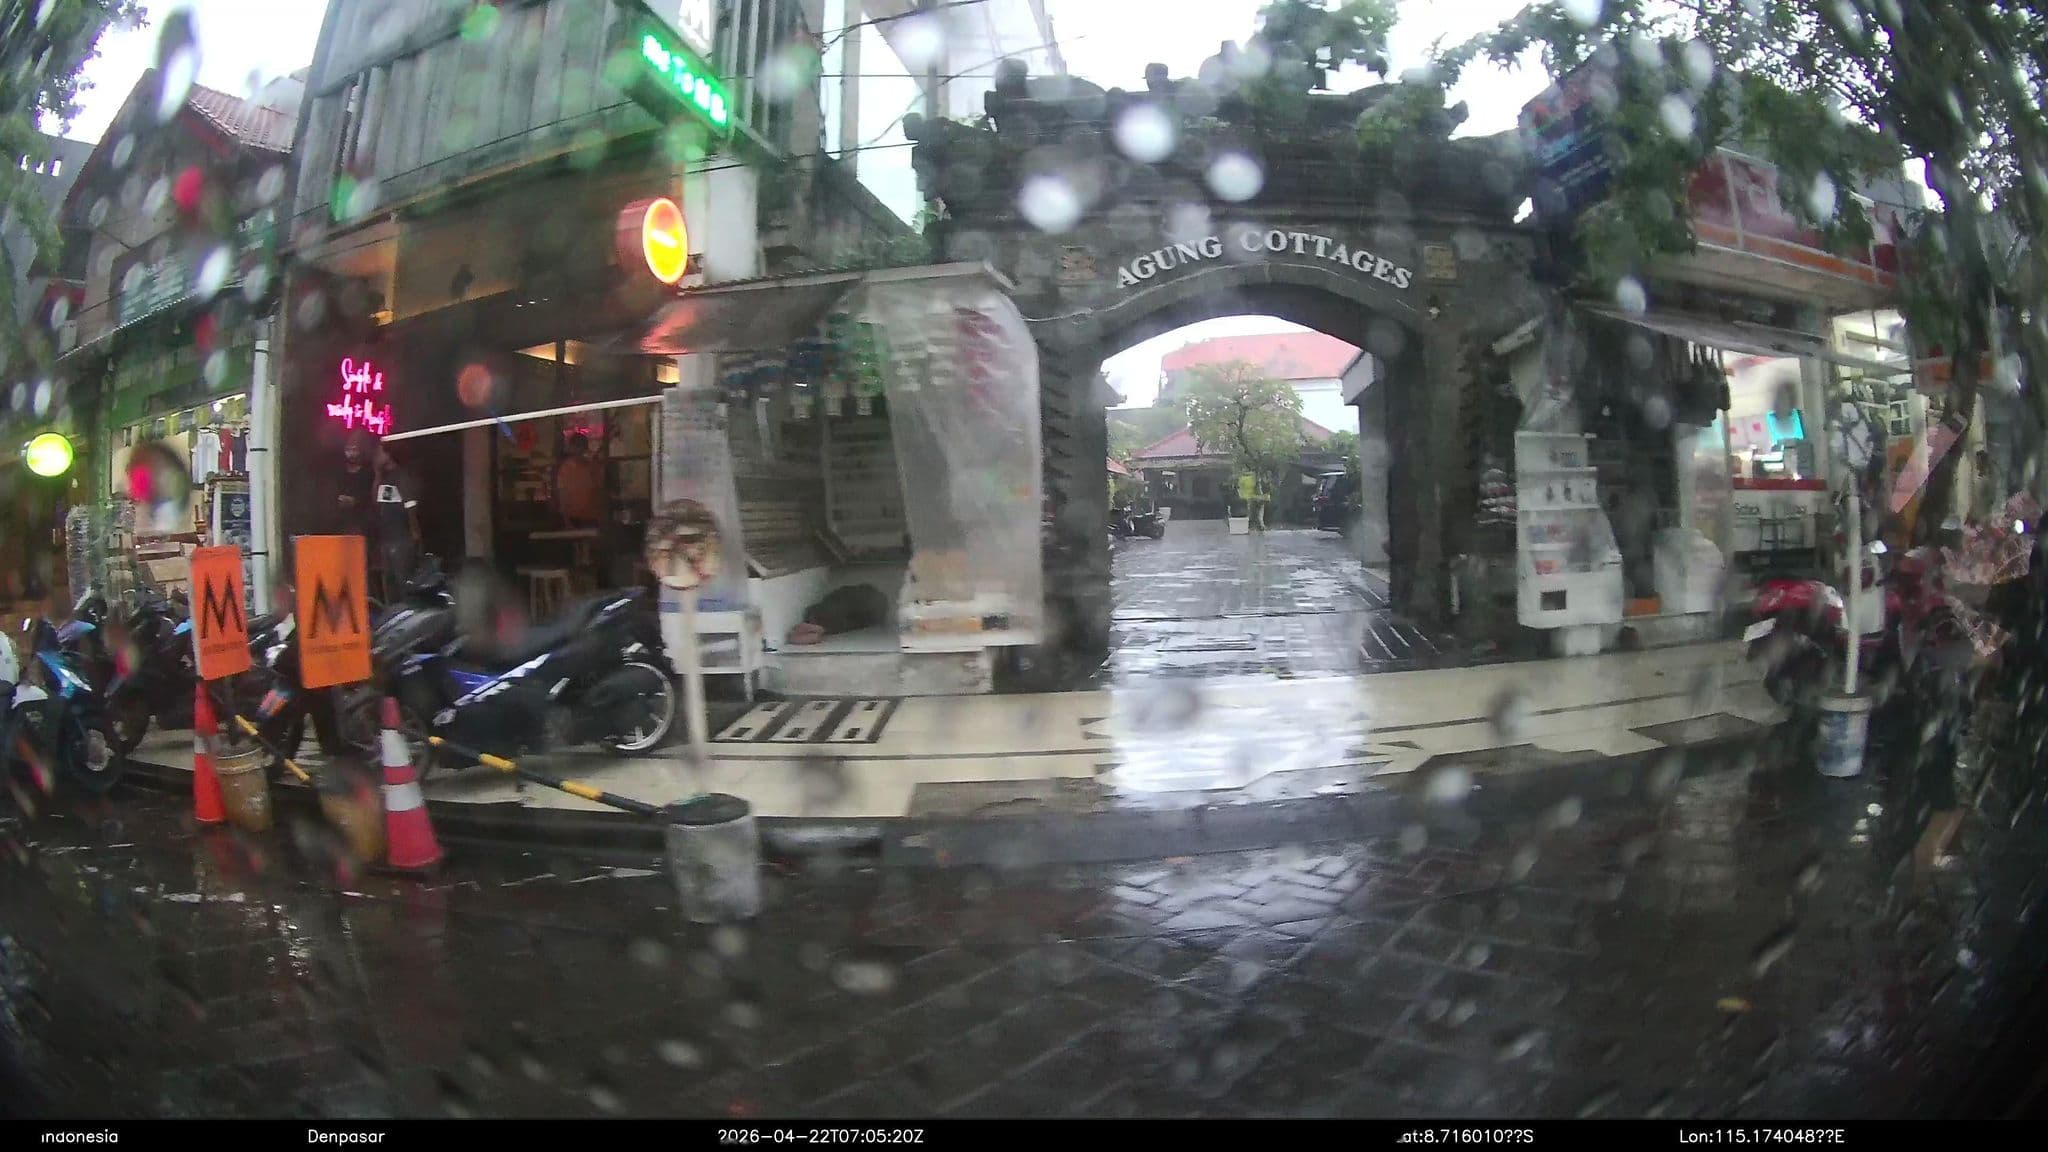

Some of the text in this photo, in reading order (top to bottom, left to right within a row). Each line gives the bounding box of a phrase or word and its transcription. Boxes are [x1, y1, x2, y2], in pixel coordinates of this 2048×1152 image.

[1115, 229, 1414, 289] AGUNG COTTAGES
[201, 573, 245, 639] M
[306, 572, 363, 640] M
